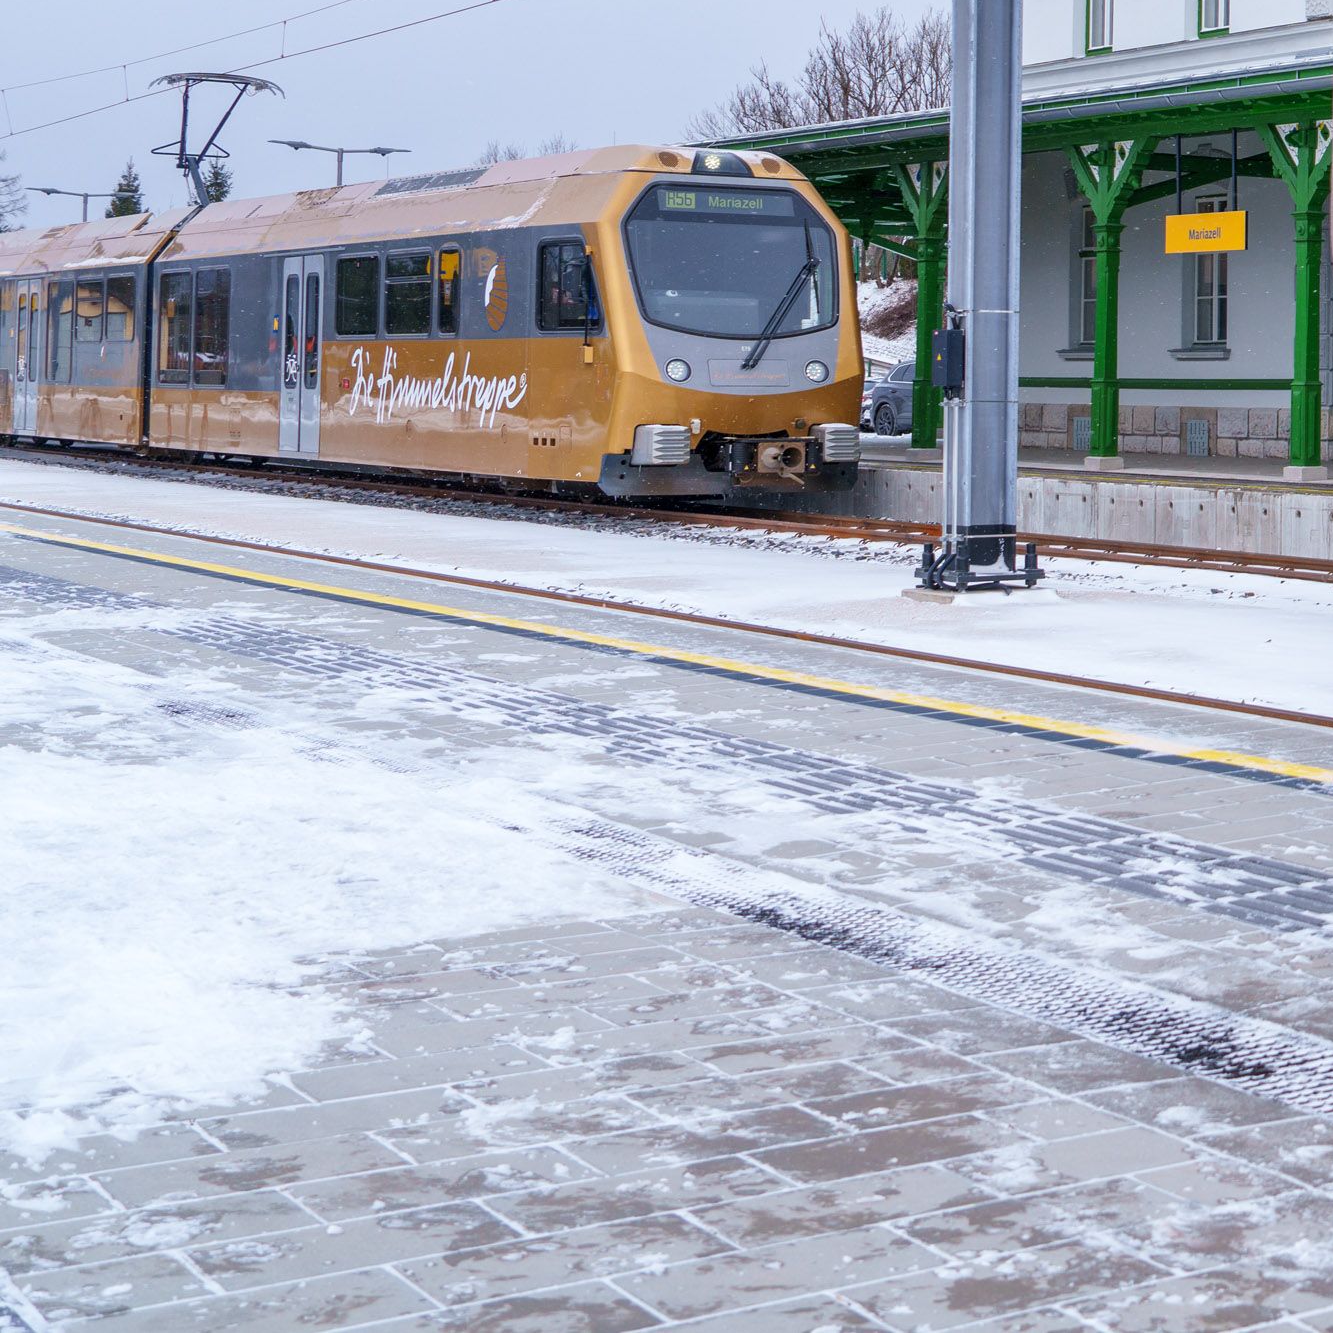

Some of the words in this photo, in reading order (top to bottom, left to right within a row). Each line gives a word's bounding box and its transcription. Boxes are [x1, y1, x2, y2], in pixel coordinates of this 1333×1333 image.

[708, 195, 763, 209] Mariazell
[1188, 227, 1222, 240] Mariazell
[350, 346, 374, 416] Die
